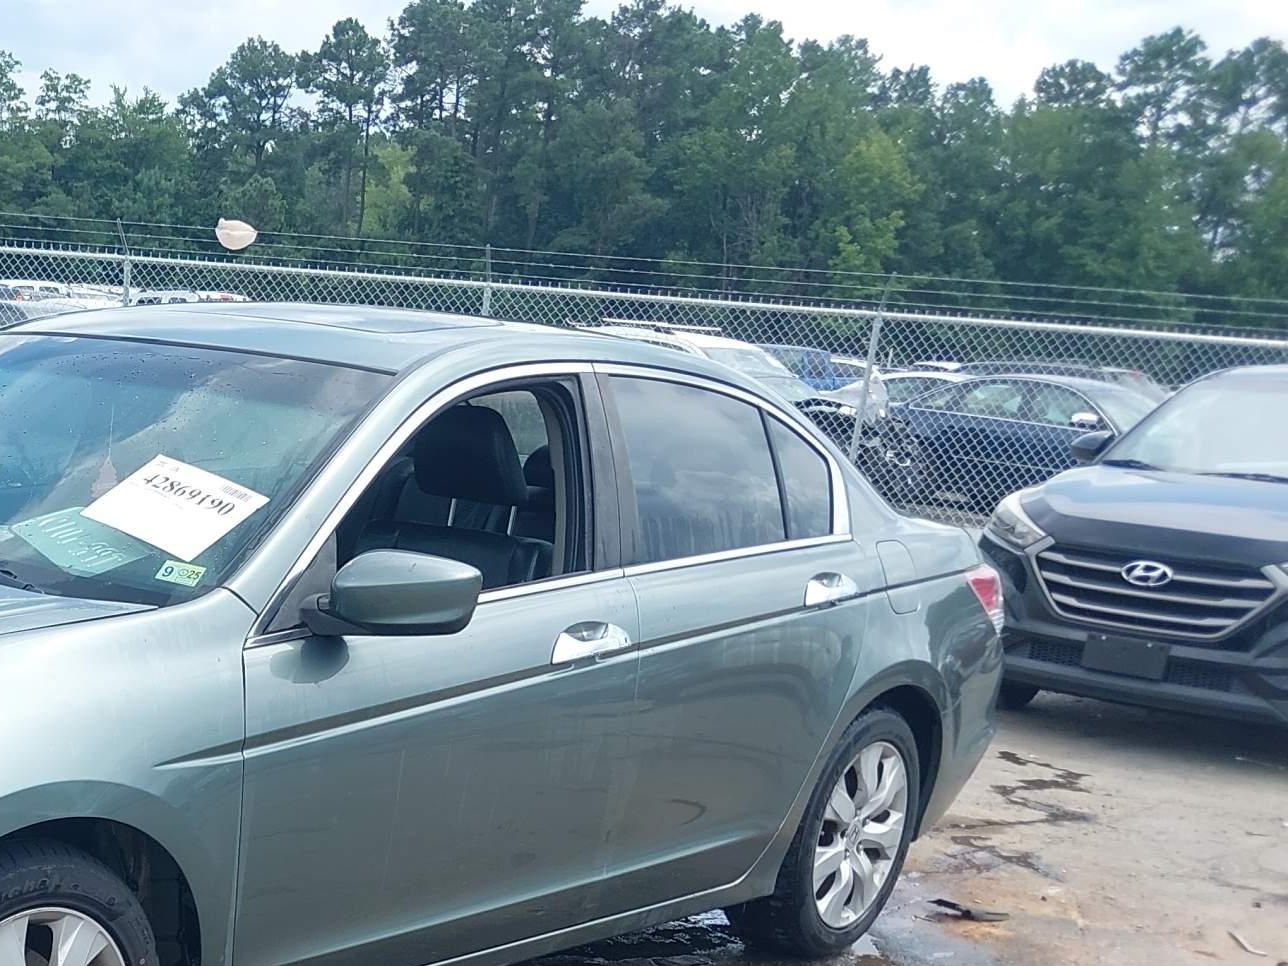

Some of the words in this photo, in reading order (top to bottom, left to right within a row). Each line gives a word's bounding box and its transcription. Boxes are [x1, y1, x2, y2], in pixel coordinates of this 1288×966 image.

[143, 473, 236, 516] 42869190
[162, 565, 175, 578] 9
[186, 569, 203, 580] 25
